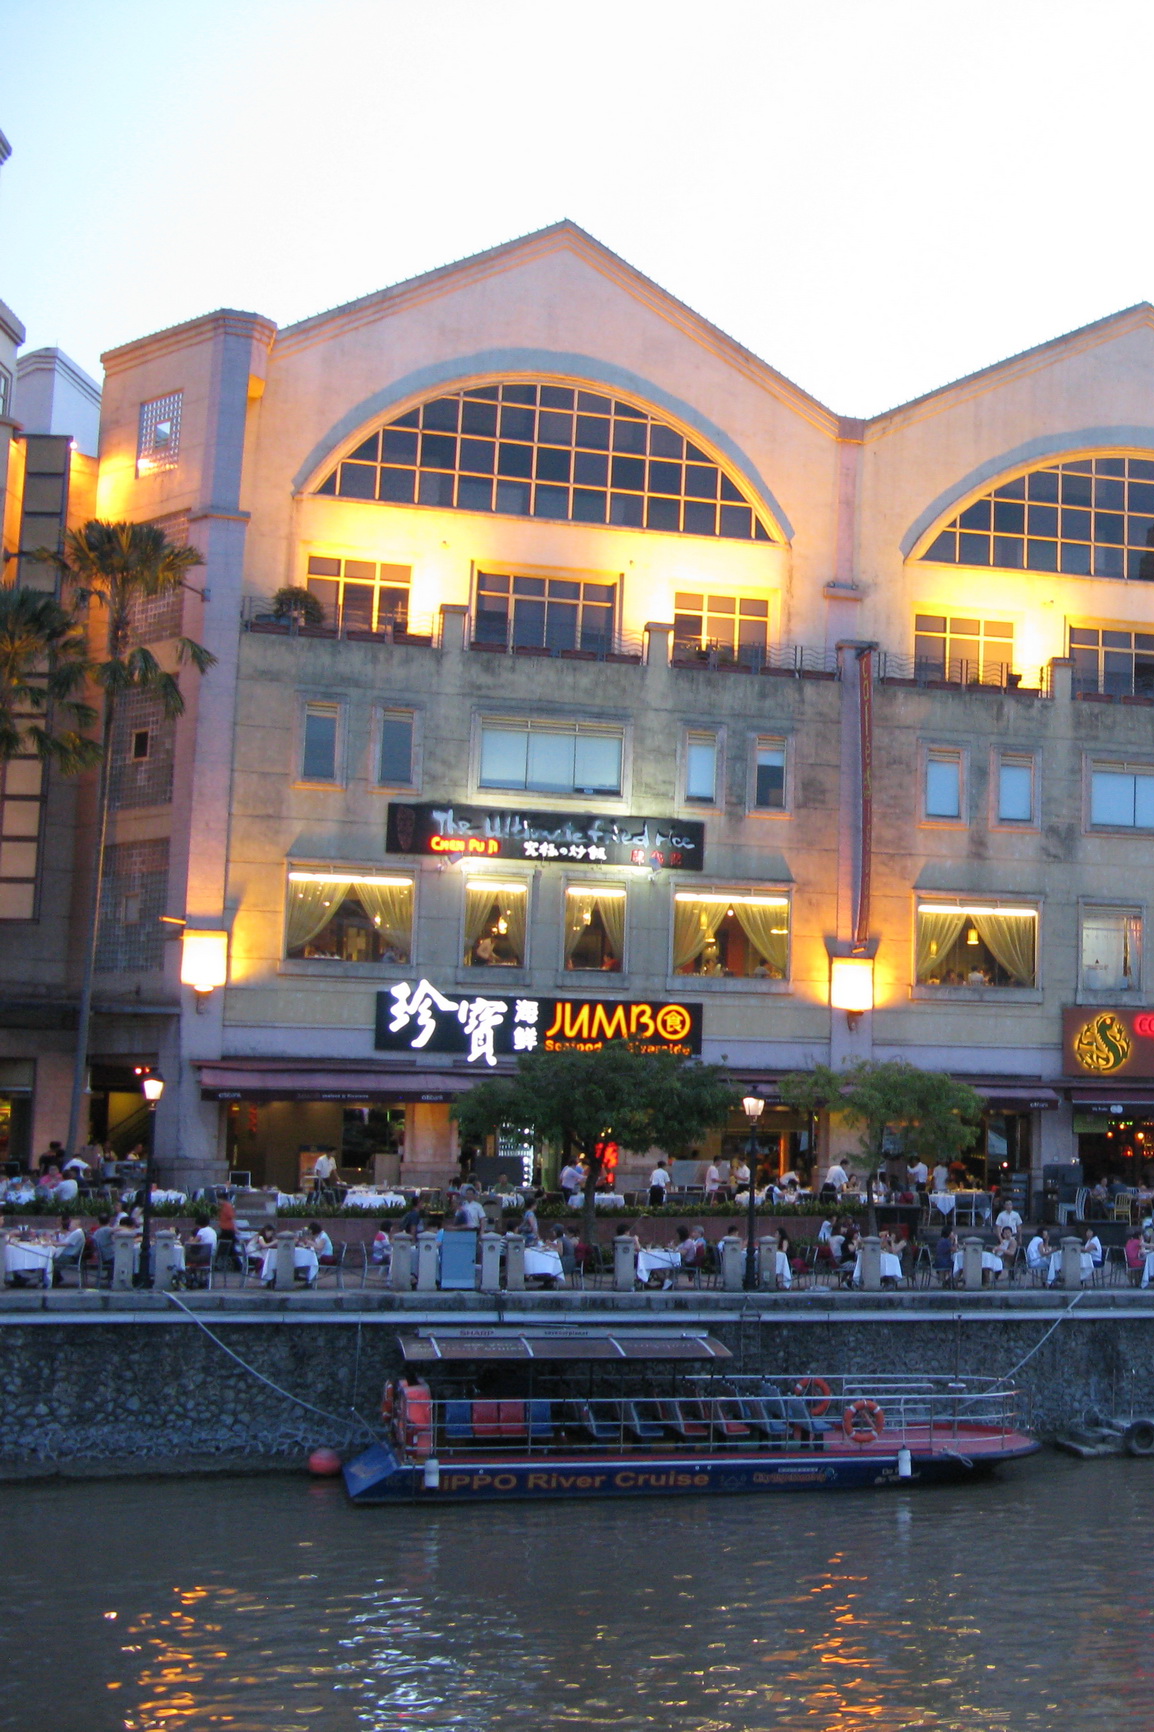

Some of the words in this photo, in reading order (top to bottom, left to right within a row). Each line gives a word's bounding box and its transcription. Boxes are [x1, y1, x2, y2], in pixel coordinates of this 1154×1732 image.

[432, 809, 475, 836] The
[588, 819, 650, 848] fried
[655, 828, 696, 850] rice
[513, 999, 540, 1051] 海鮮
[459, 1329, 495, 1337] SHARP
[528, 1471, 603, 1489] River
[614, 1471, 710, 1488] Cruise
